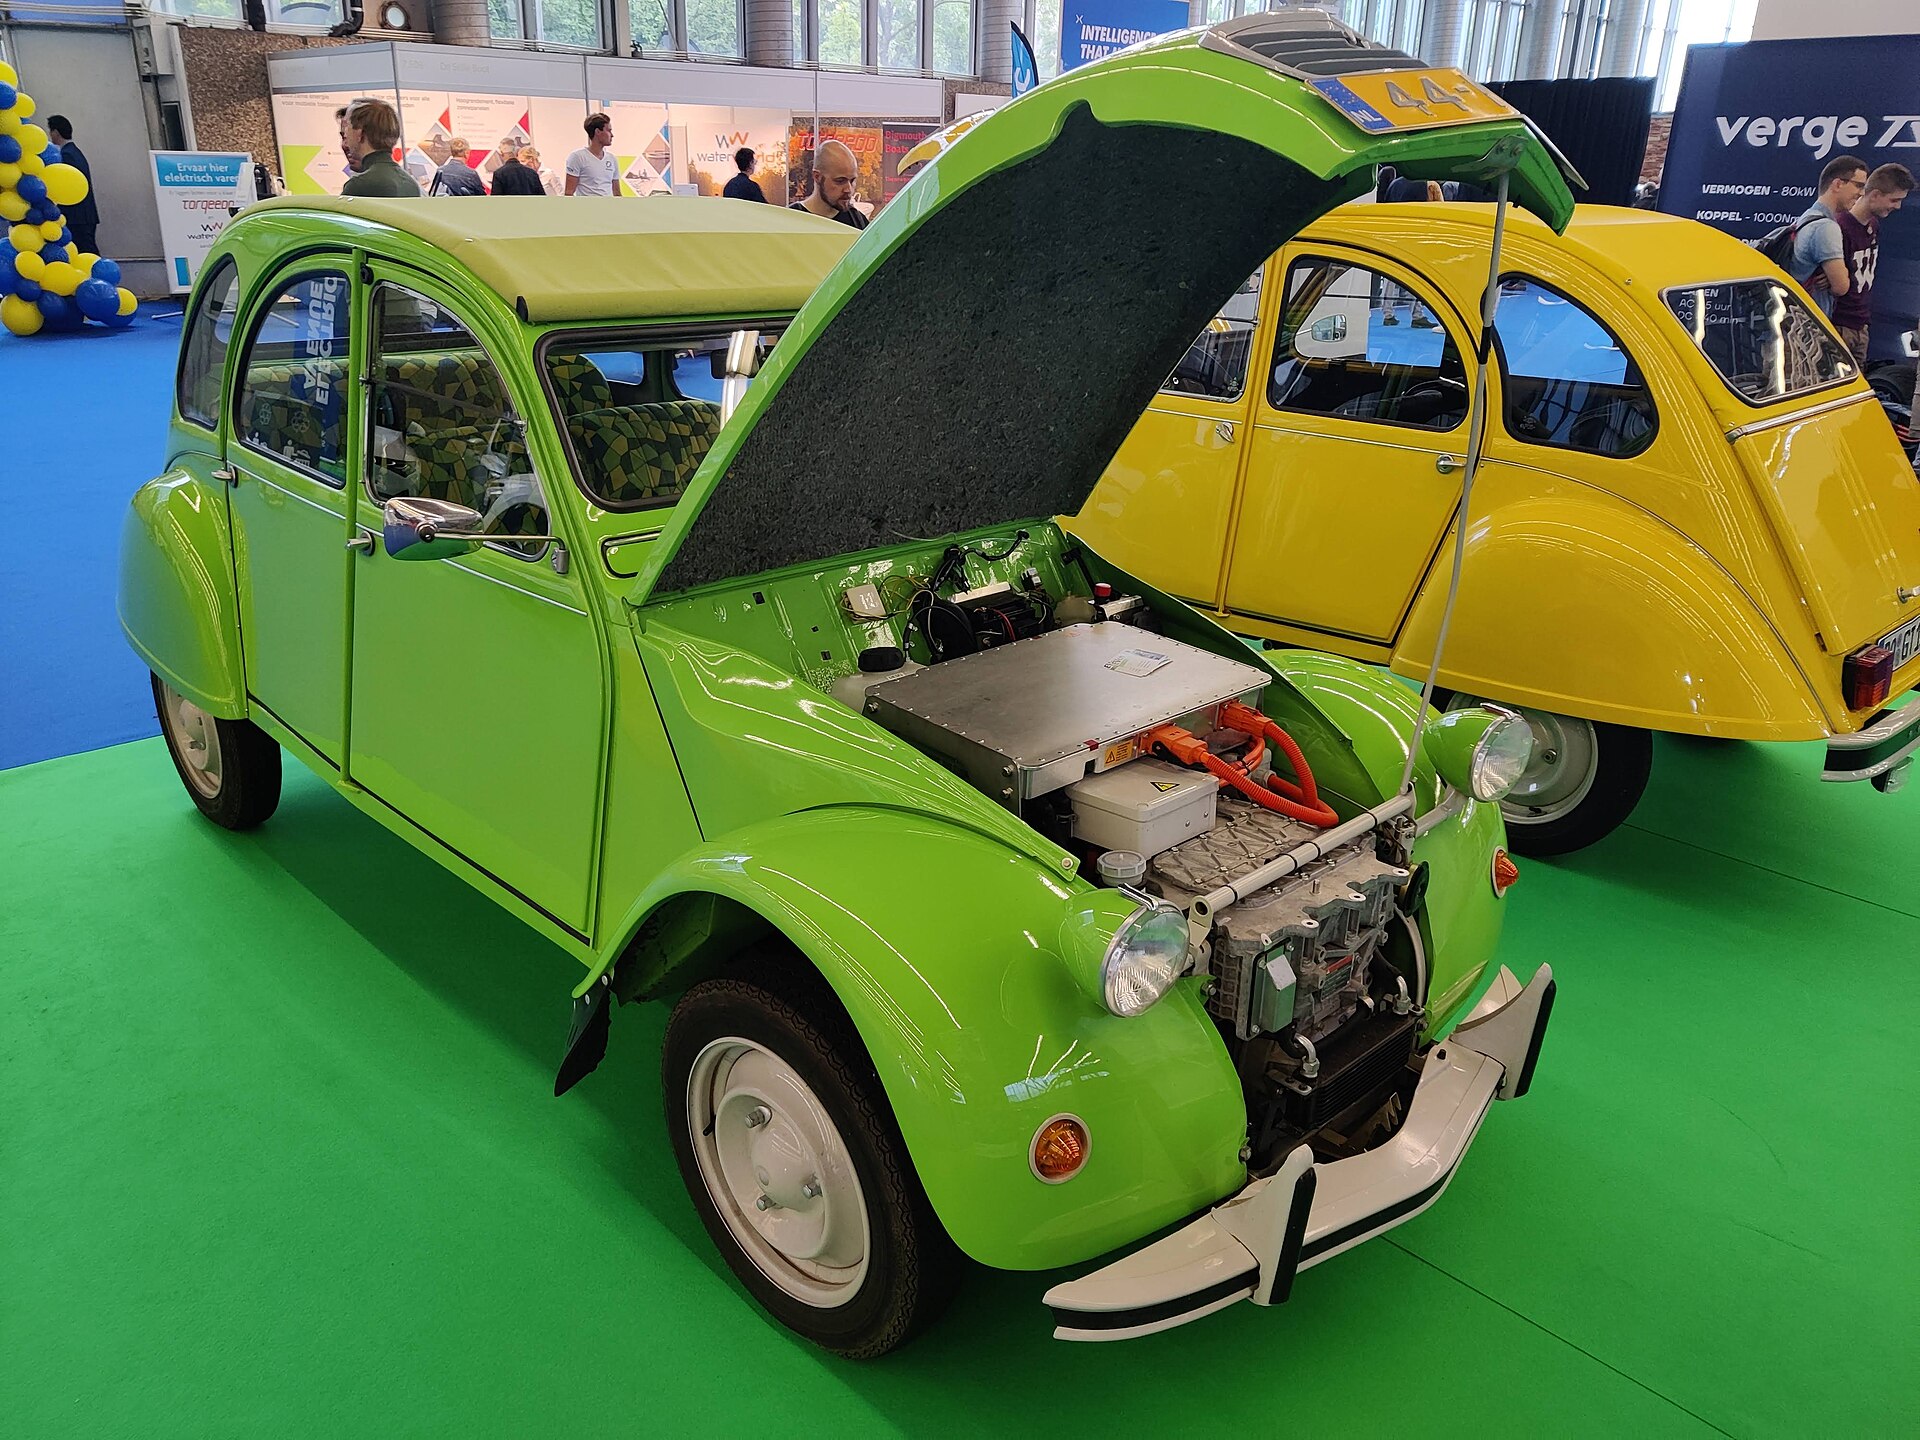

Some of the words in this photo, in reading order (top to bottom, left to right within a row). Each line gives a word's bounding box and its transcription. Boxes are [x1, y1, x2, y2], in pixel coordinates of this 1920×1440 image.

[1081, 25, 1157, 44] INTELLIGENC
[1081, 44, 1109, 59] THAT
[1351, 109, 1382, 123] NL
[1716, 115, 1868, 160] verge
[177, 162, 207, 172] Ervaar
[209, 163, 229, 172] hier
[164, 173, 213, 183] elektrisch
[1702, 184, 1771, 196] VERMOGEN
[1781, 186, 1816, 197] 80kW
[1696, 210, 1742, 222] KOPPEL
[1679, 298, 1695, 309] AC
